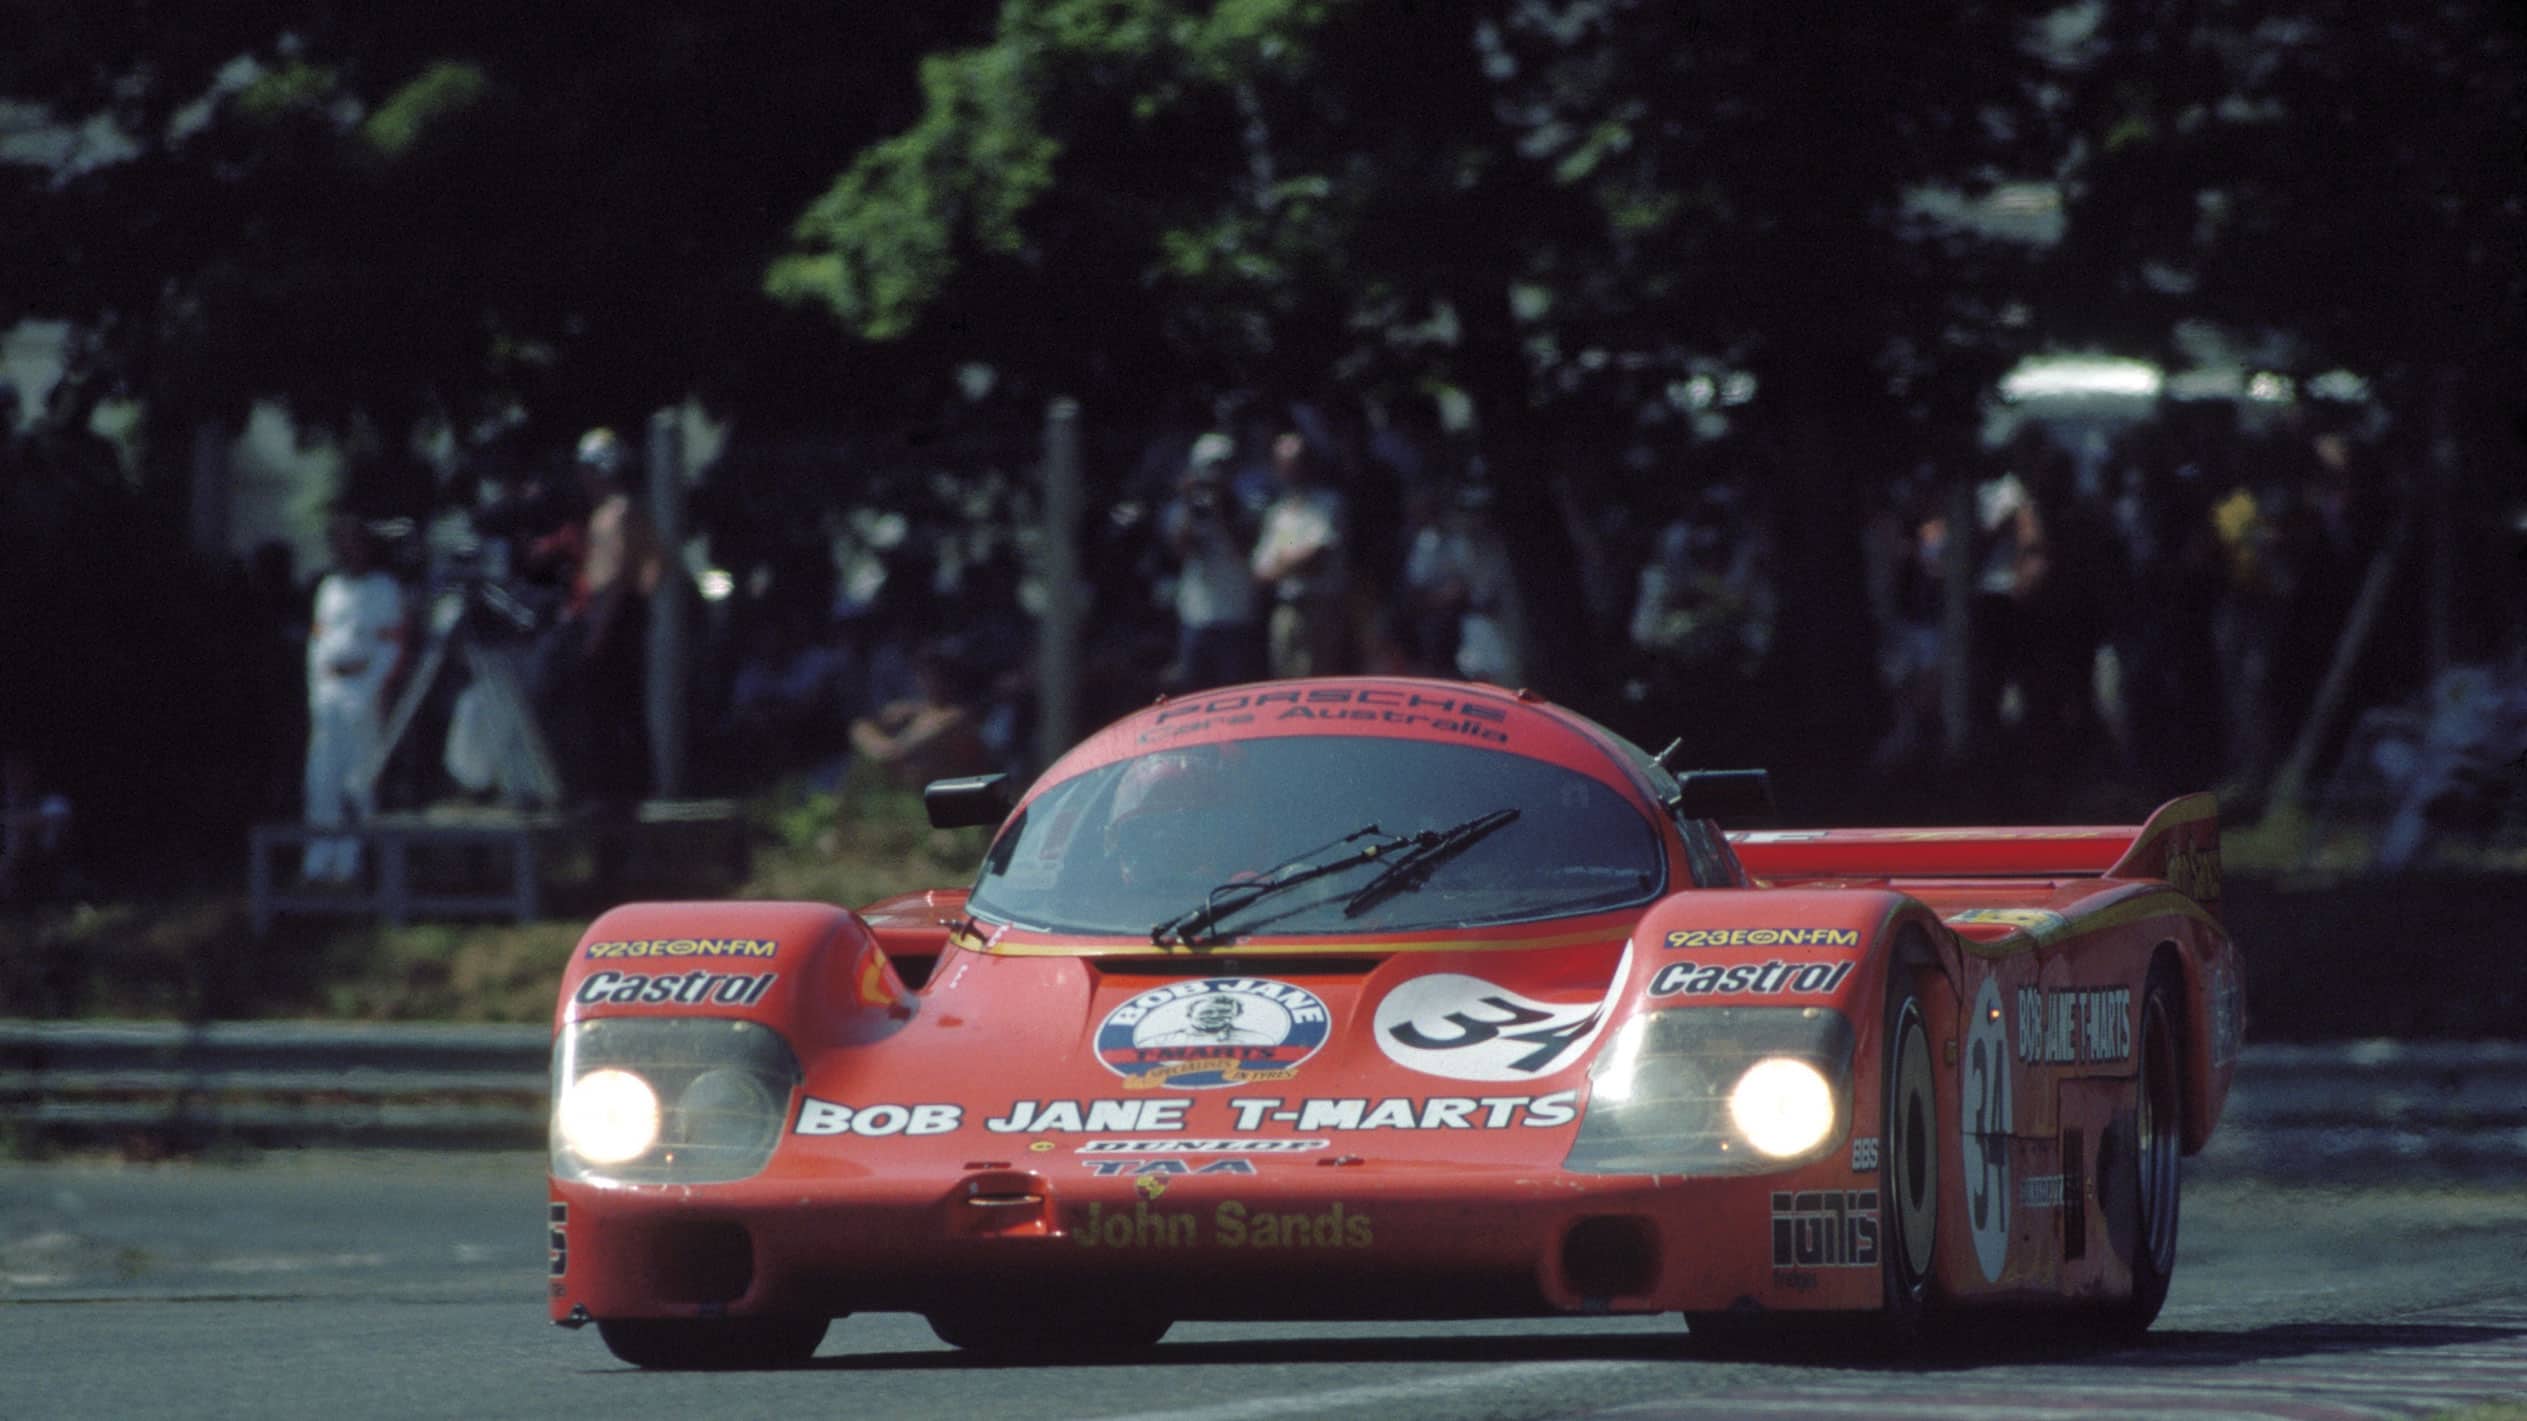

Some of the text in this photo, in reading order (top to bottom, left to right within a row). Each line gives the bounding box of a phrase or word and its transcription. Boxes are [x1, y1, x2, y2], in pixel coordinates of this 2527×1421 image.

[1137, 705, 1509, 745] Cars Australia
[1156, 688, 1507, 725] PORSCHE
[574, 969, 778, 1006] Castrol
[1648, 959, 1856, 997] Castrol
[1109, 979, 1325, 1026] BOB JANE
[1388, 996, 1605, 1073] 34
[2017, 986, 2042, 1064] BOB
[2044, 987, 2076, 1064] JANE
[2079, 985, 2131, 1063] T-MARTS
[795, 1089, 1579, 1136] BOB JANE T-MARTS
[1079, 1139, 1327, 1153] DUNLOP
[1852, 1137, 1880, 1171] BBS
[1971, 1037, 2006, 1234] 34
[1083, 1159, 1258, 1176] TAA
[1071, 1199, 1375, 1248] John Sands
